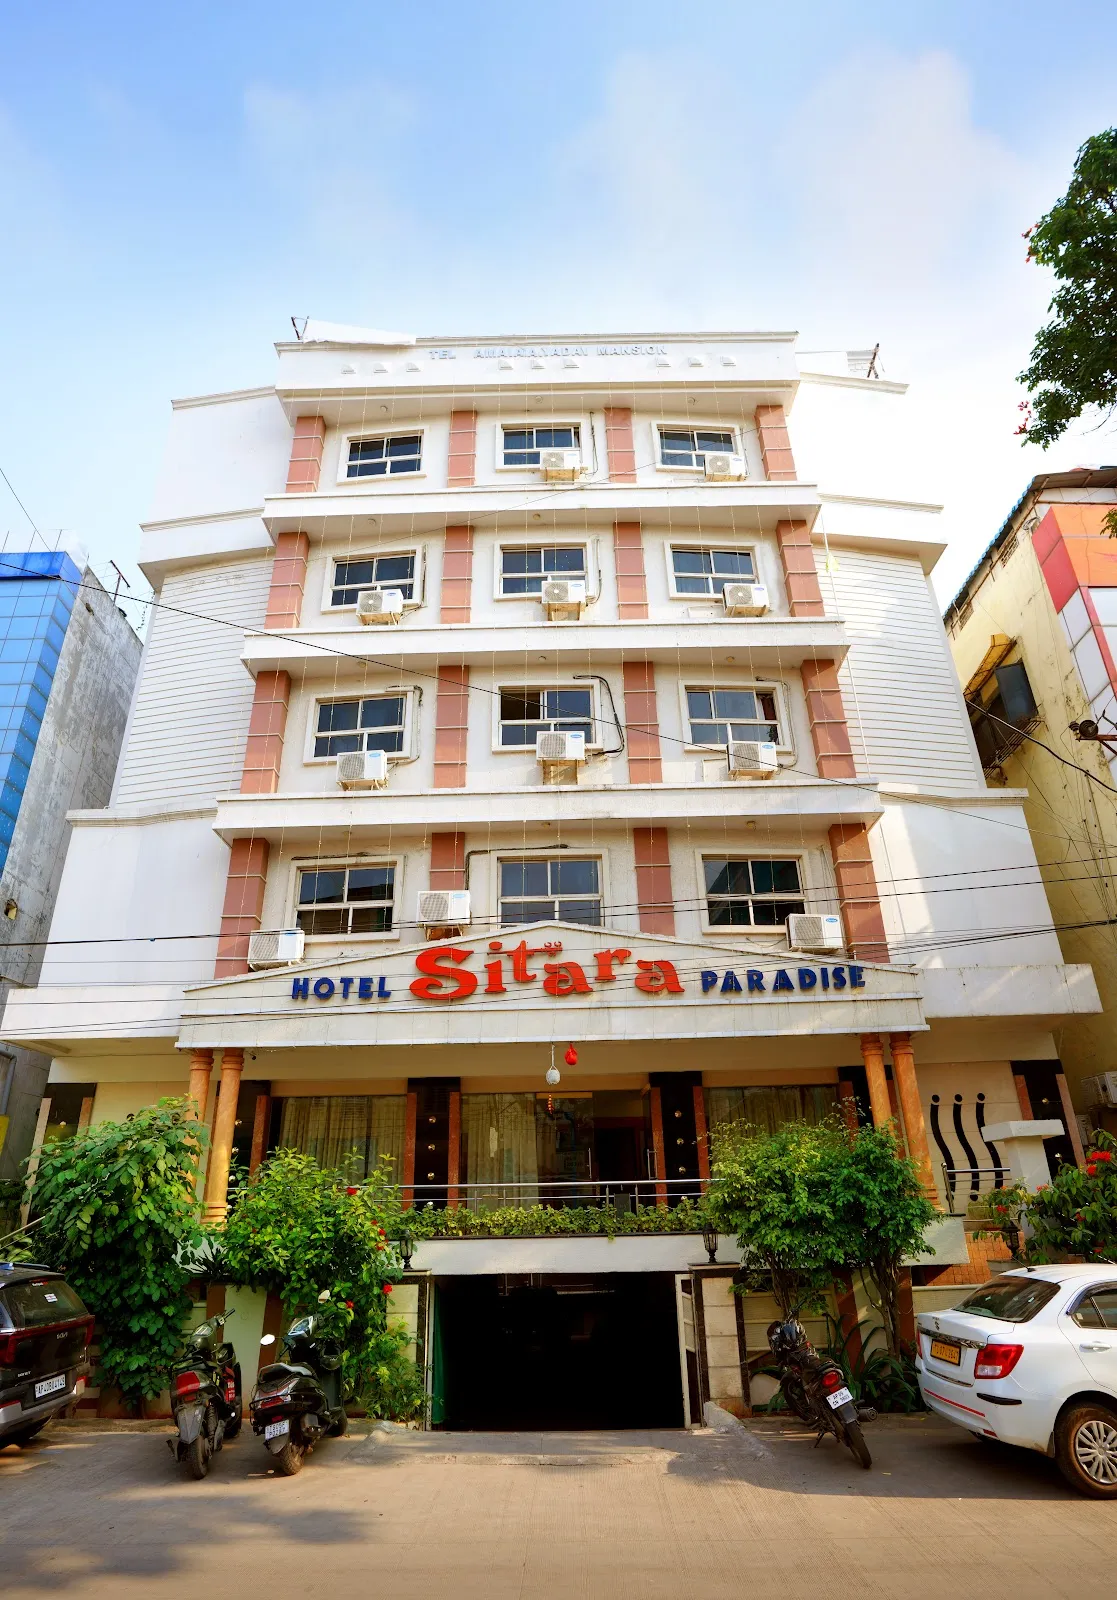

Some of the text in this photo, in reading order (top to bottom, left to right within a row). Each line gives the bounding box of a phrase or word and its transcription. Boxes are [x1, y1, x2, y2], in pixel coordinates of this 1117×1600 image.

[597, 345, 667, 357] MANSION
[291, 940, 866, 1001] HOTEL Sitara PARADISE
